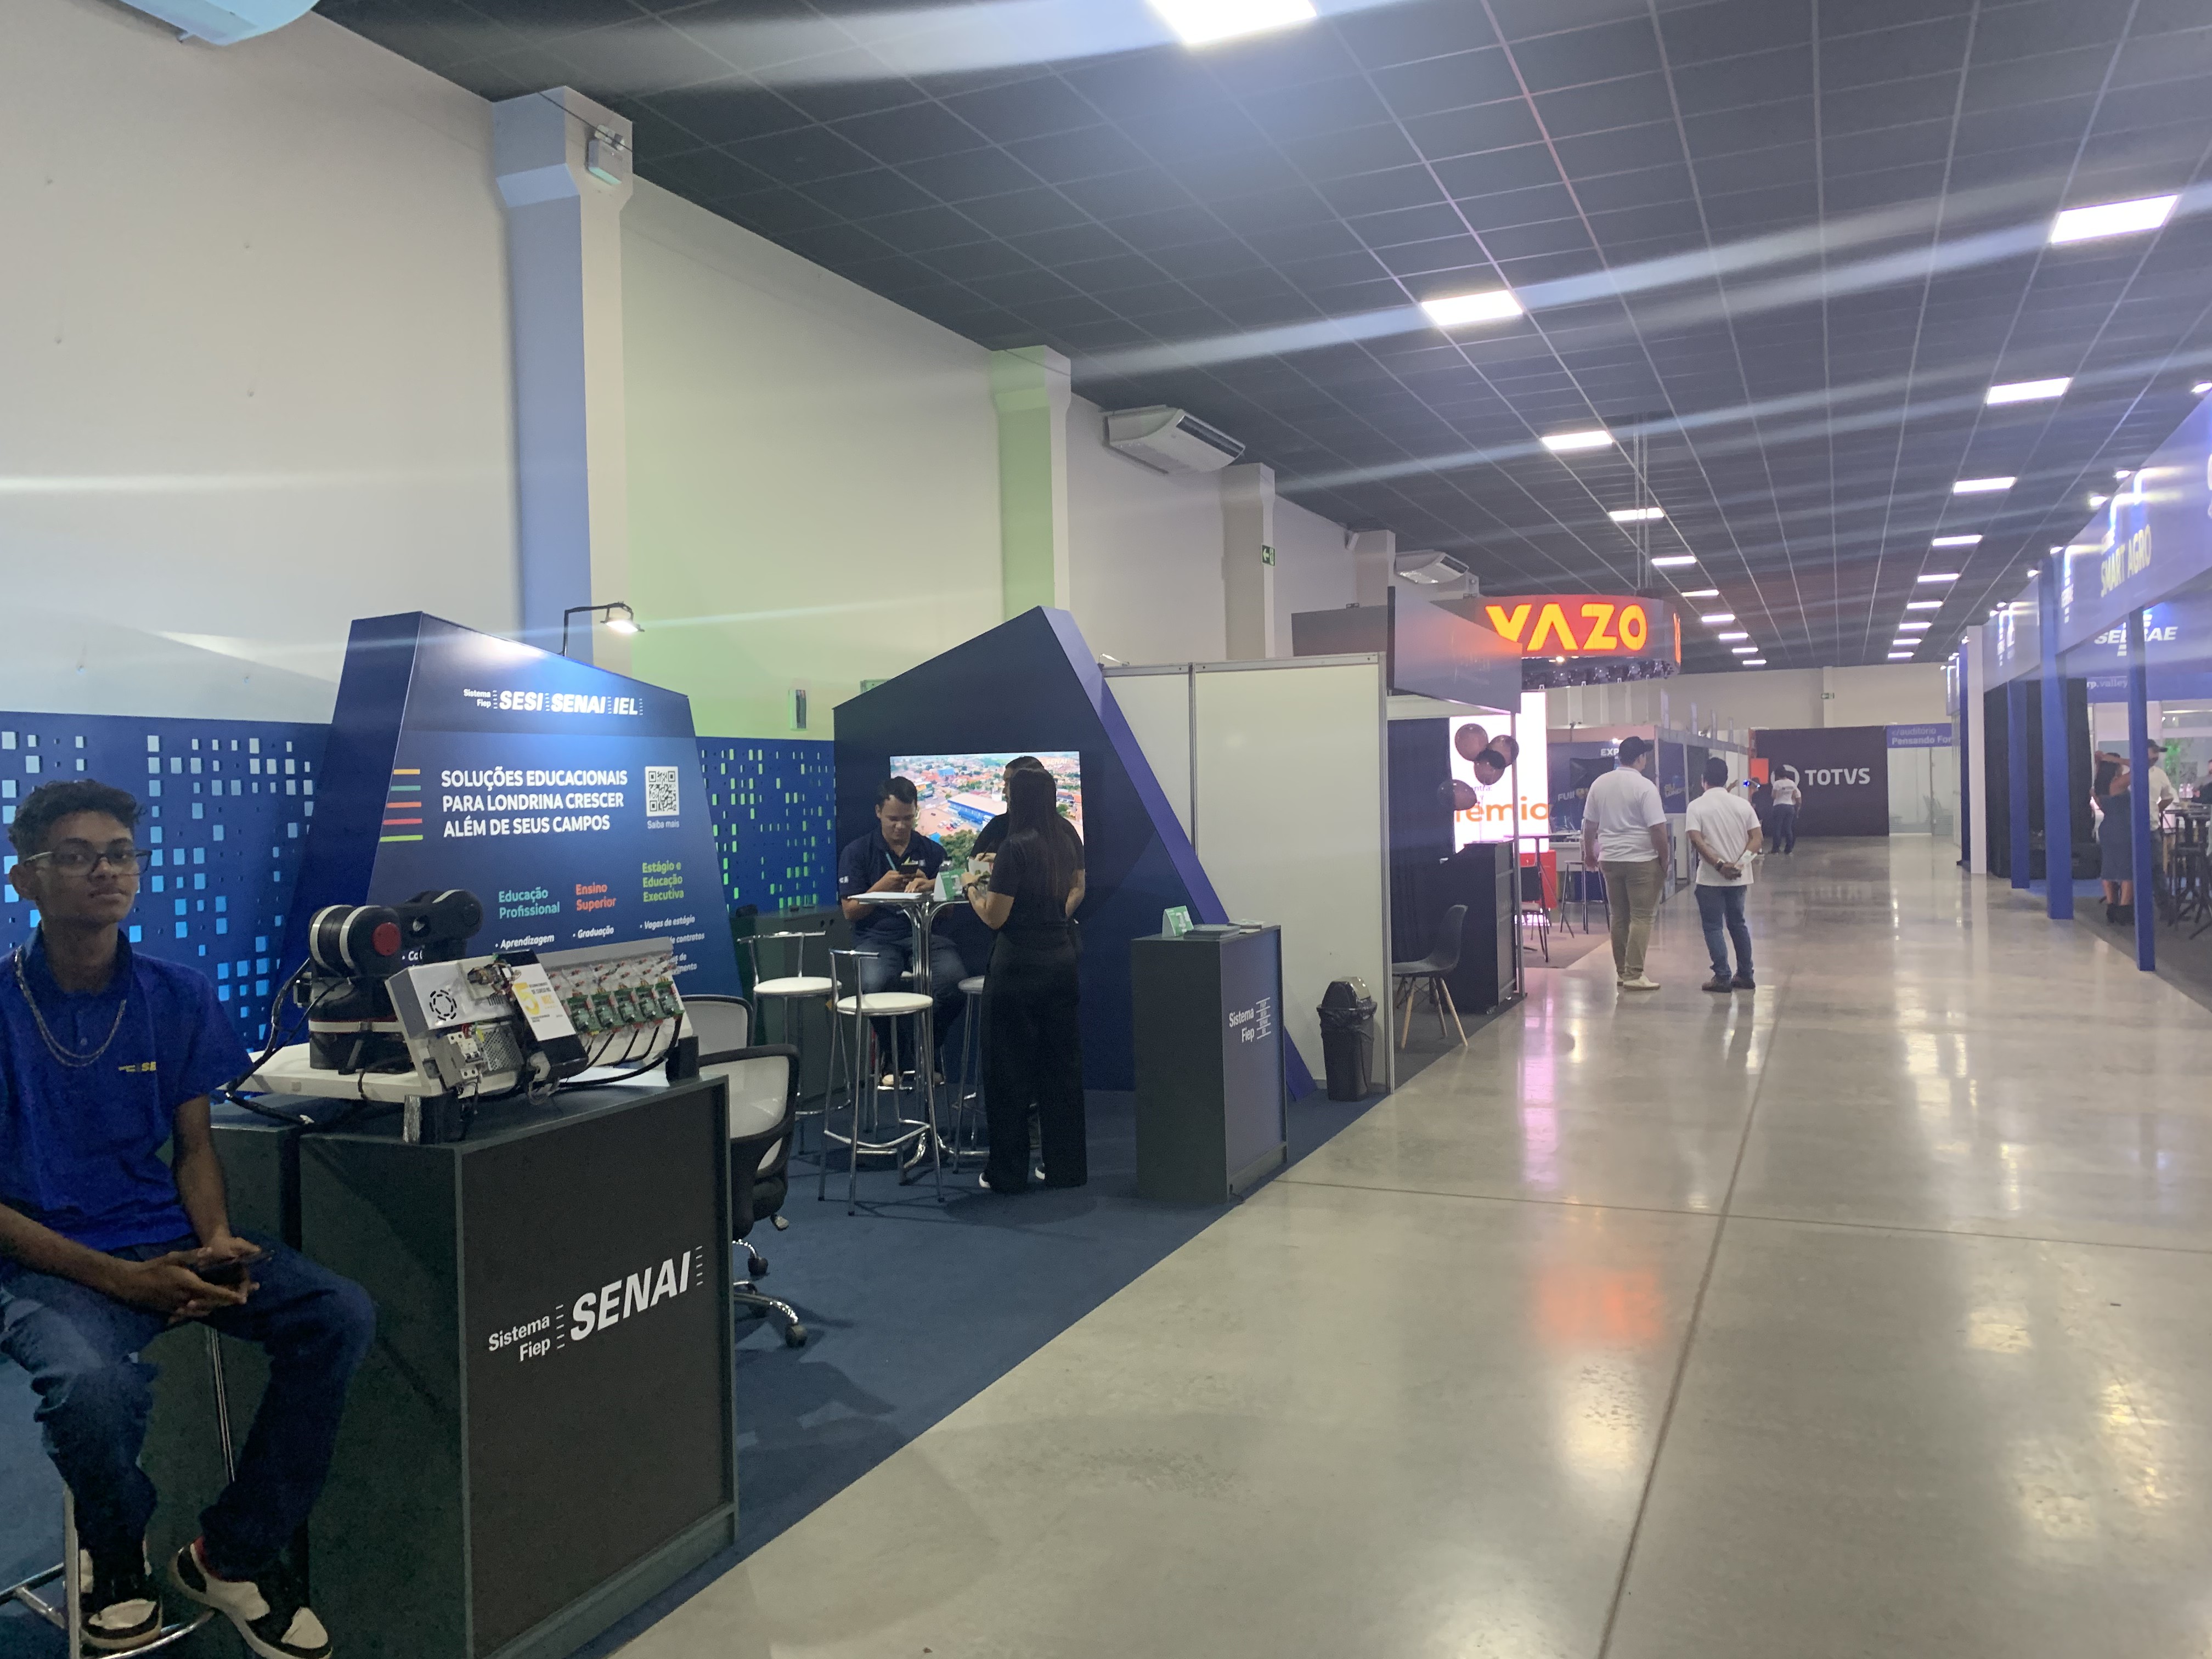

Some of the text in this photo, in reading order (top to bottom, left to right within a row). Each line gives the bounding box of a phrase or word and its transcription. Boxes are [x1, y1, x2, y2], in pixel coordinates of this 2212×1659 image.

[2101, 544, 2125, 597] SMART
[2128, 524, 2152, 578] AGRO
[463, 689, 491, 698] Sistema
[477, 699, 492, 708] Fiep
[499, 691, 639, 715] SESI SENAI IEL
[1892, 736, 1935, 745] Pensando
[441, 766, 628, 791] SOLUÇÕES EDUCACIONAIS
[1804, 768, 1871, 786] TOTVS
[442, 792, 624, 812] PARA LONDRINA CRESCER
[443, 815, 610, 837] ALÉM DE SEUS CAMPOS
[647, 820, 680, 829] Saiba mais
[642, 860, 674, 874] Estágio
[576, 882, 607, 895] Ensino
[643, 874, 683, 888] Educação
[499, 887, 549, 903] Educação
[643, 888, 684, 902] Executiva
[499, 901, 560, 919] Profissional
[576, 896, 617, 912] Superior
[644, 915, 696, 930] Vagas de estágio
[578, 926, 614, 939] Graduação
[676, 933, 705, 944] contratos
[500, 934, 555, 950] Aprendizagem
[679, 952, 687, 961] de
[1229, 1008, 1254, 1028] Sistema
[1242, 1027, 1255, 1043] Fiep
[570, 1250, 691, 1341] SENAI
[489, 1315, 550, 1351] Sistema
[520, 1336, 550, 1362] Fiep
